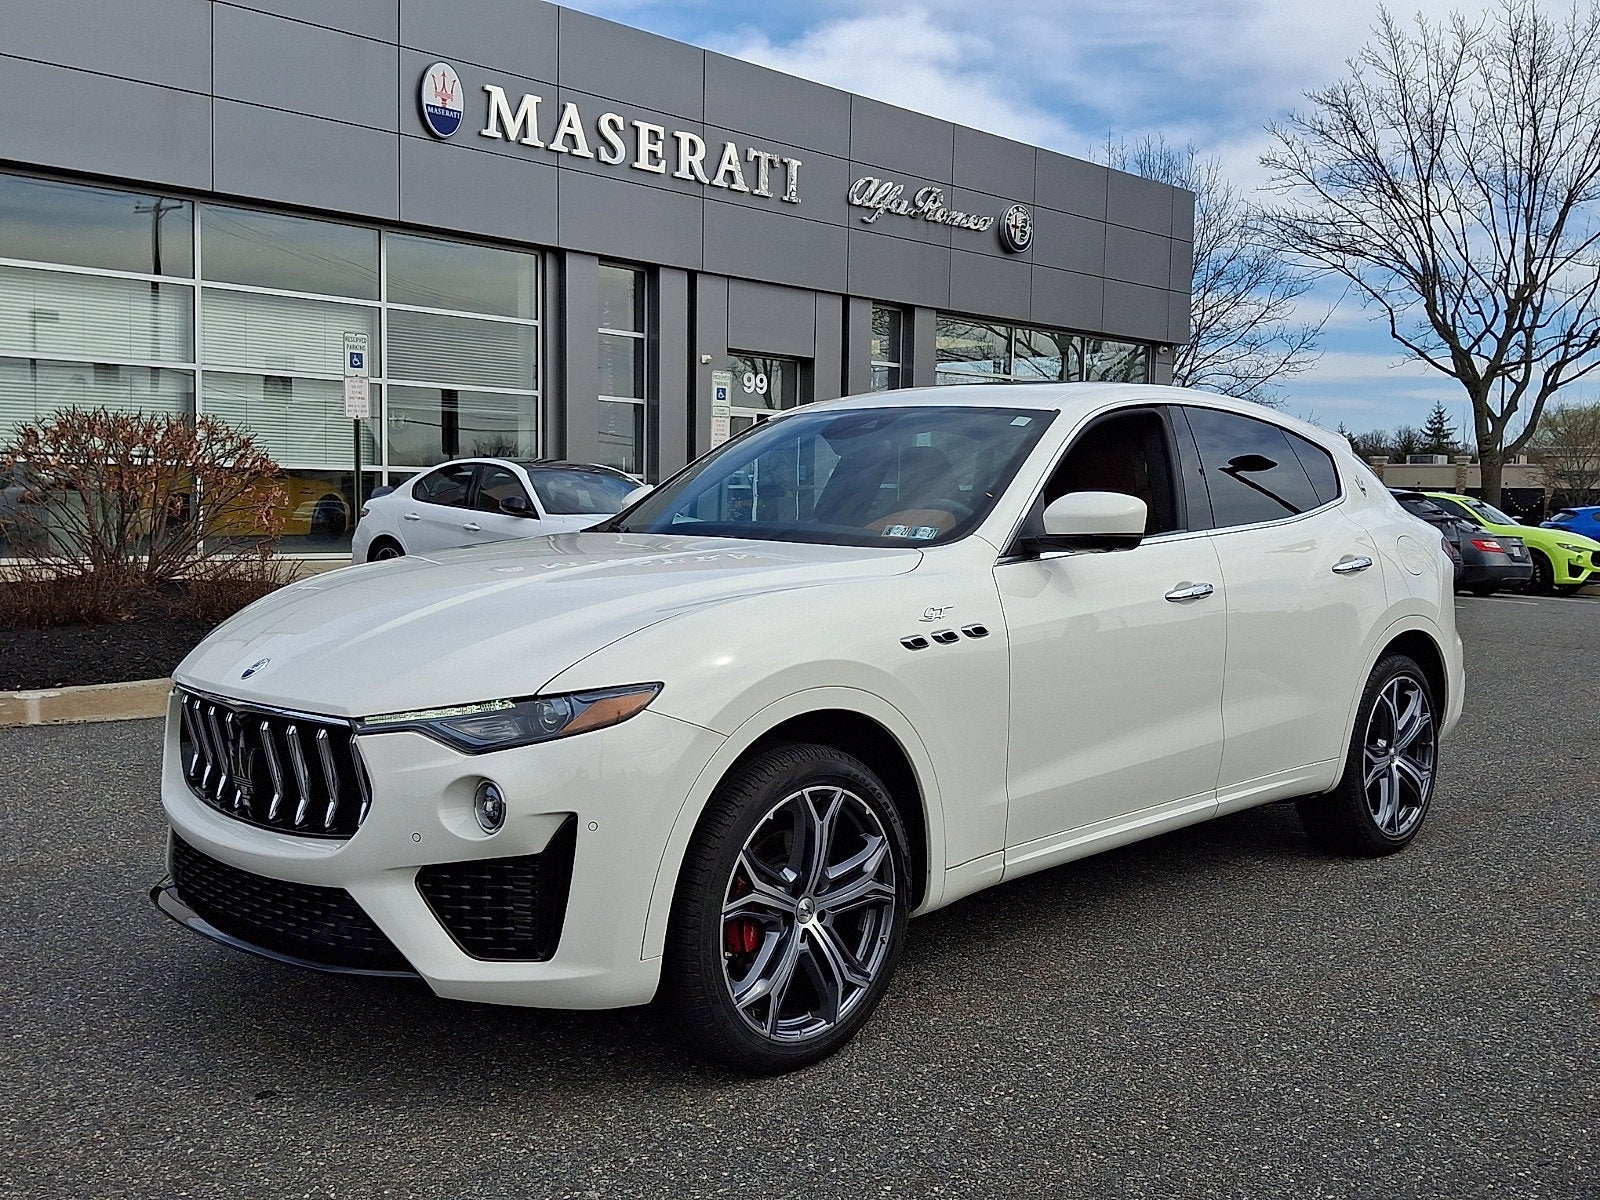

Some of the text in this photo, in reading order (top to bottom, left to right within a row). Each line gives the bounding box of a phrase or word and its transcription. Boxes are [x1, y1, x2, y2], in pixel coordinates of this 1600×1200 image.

[427, 105, 460, 119] MASERATI
[480, 84, 802, 204] MASERATI
[849, 177, 909, 224] Alfa
[914, 187, 995, 232] Romeo
[743, 372, 768, 395] 99
[918, 604, 954, 623] GT
